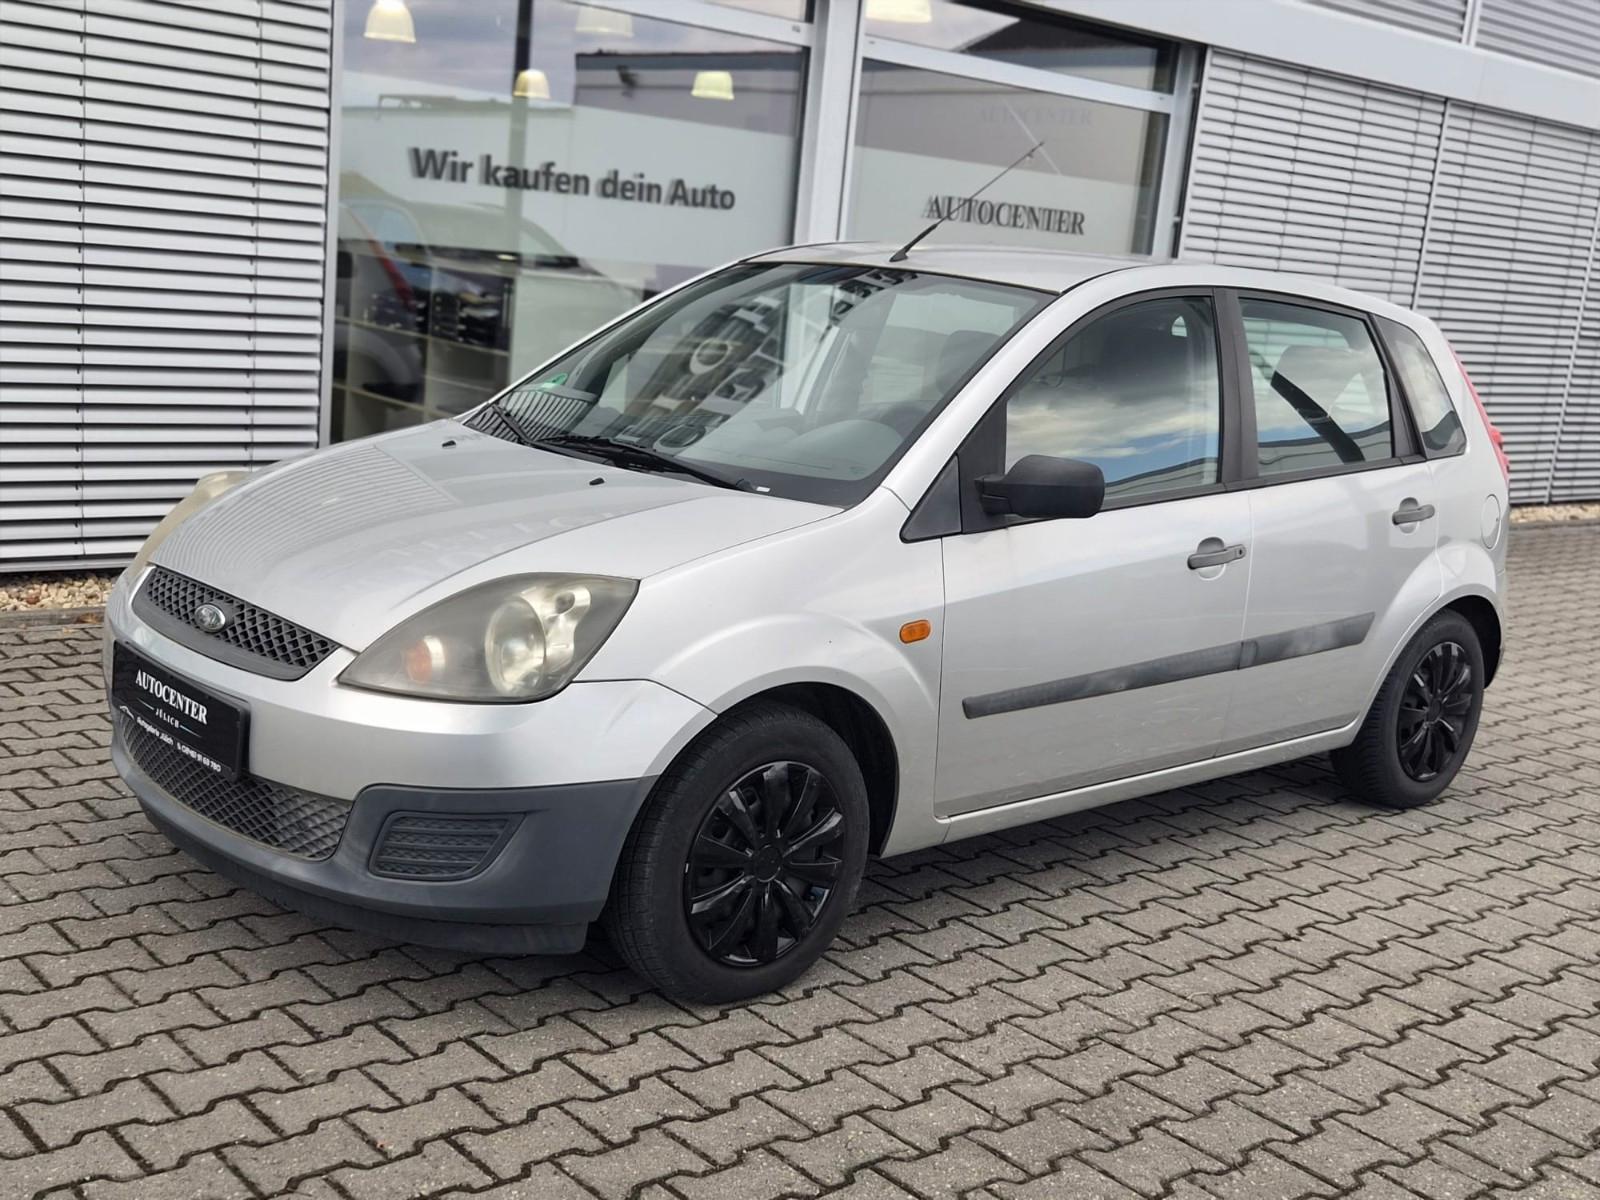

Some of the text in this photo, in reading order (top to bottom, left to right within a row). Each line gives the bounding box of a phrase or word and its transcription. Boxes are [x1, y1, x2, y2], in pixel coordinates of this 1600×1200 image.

[409, 146, 735, 210] Wir kaufen dein Auto
[923, 194, 1086, 235] AUTOCENTER
[135, 669, 208, 725] AUTOCENTER
